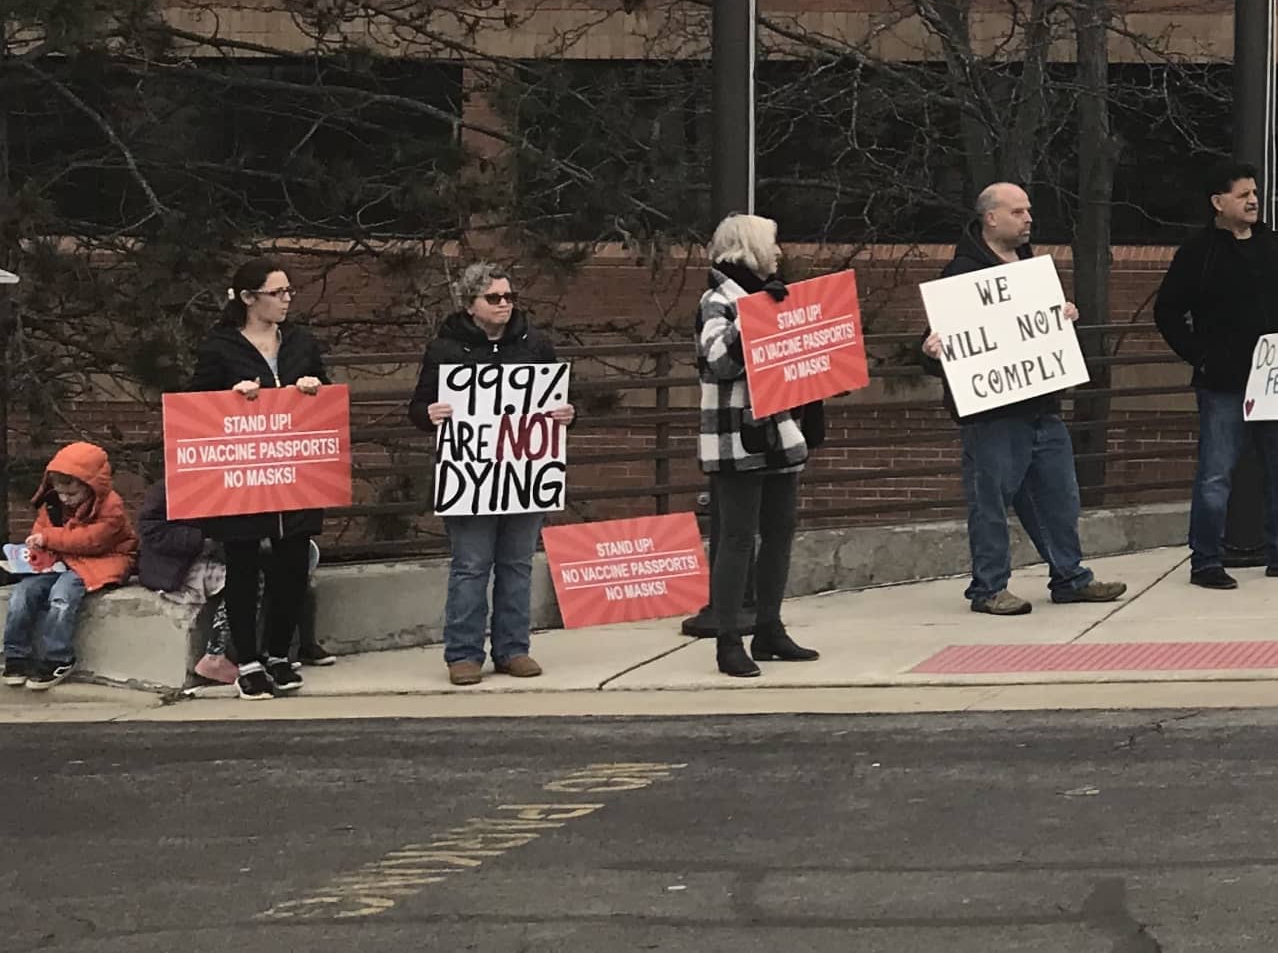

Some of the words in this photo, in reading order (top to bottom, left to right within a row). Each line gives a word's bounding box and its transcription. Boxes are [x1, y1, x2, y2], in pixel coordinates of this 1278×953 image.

[975, 276, 1011, 306] WE
[777, 307, 805, 329] STAND
[806, 304, 822, 321] UP!
[752, 347, 765, 365] NO
[766, 336, 802, 360] VACCINE
[803, 322, 855, 350] PASSPORTS!
[940, 326, 997, 362] WILL
[1017, 304, 1063, 342] NOT
[784, 365, 798, 382] NO
[799, 355, 831, 377] MASKS!
[971, 349, 1067, 398] COMPLY
[446, 364, 568, 416] 99.9%
[224, 415, 266, 434] STAND
[270, 413, 292, 430] UP!
[436, 418, 492, 463] ARE
[496, 411, 561, 462] NOT
[177, 447, 197, 464] NO
[200, 442, 256, 462] VACCINE
[260, 438, 339, 458] PASSPORTS!
[224, 471, 243, 488] NO
[247, 467, 295, 486] MASKS!
[435, 460, 565, 514] DYING
[596, 541, 632, 557] STAND
[634, 538, 654, 553] UP!
[562, 569, 580, 583] NO
[582, 564, 629, 580] VACCINE
[632, 556, 699, 576] PASSPORTS!
[605, 587, 623, 600] NO
[625, 581, 668, 598] MASKS!
